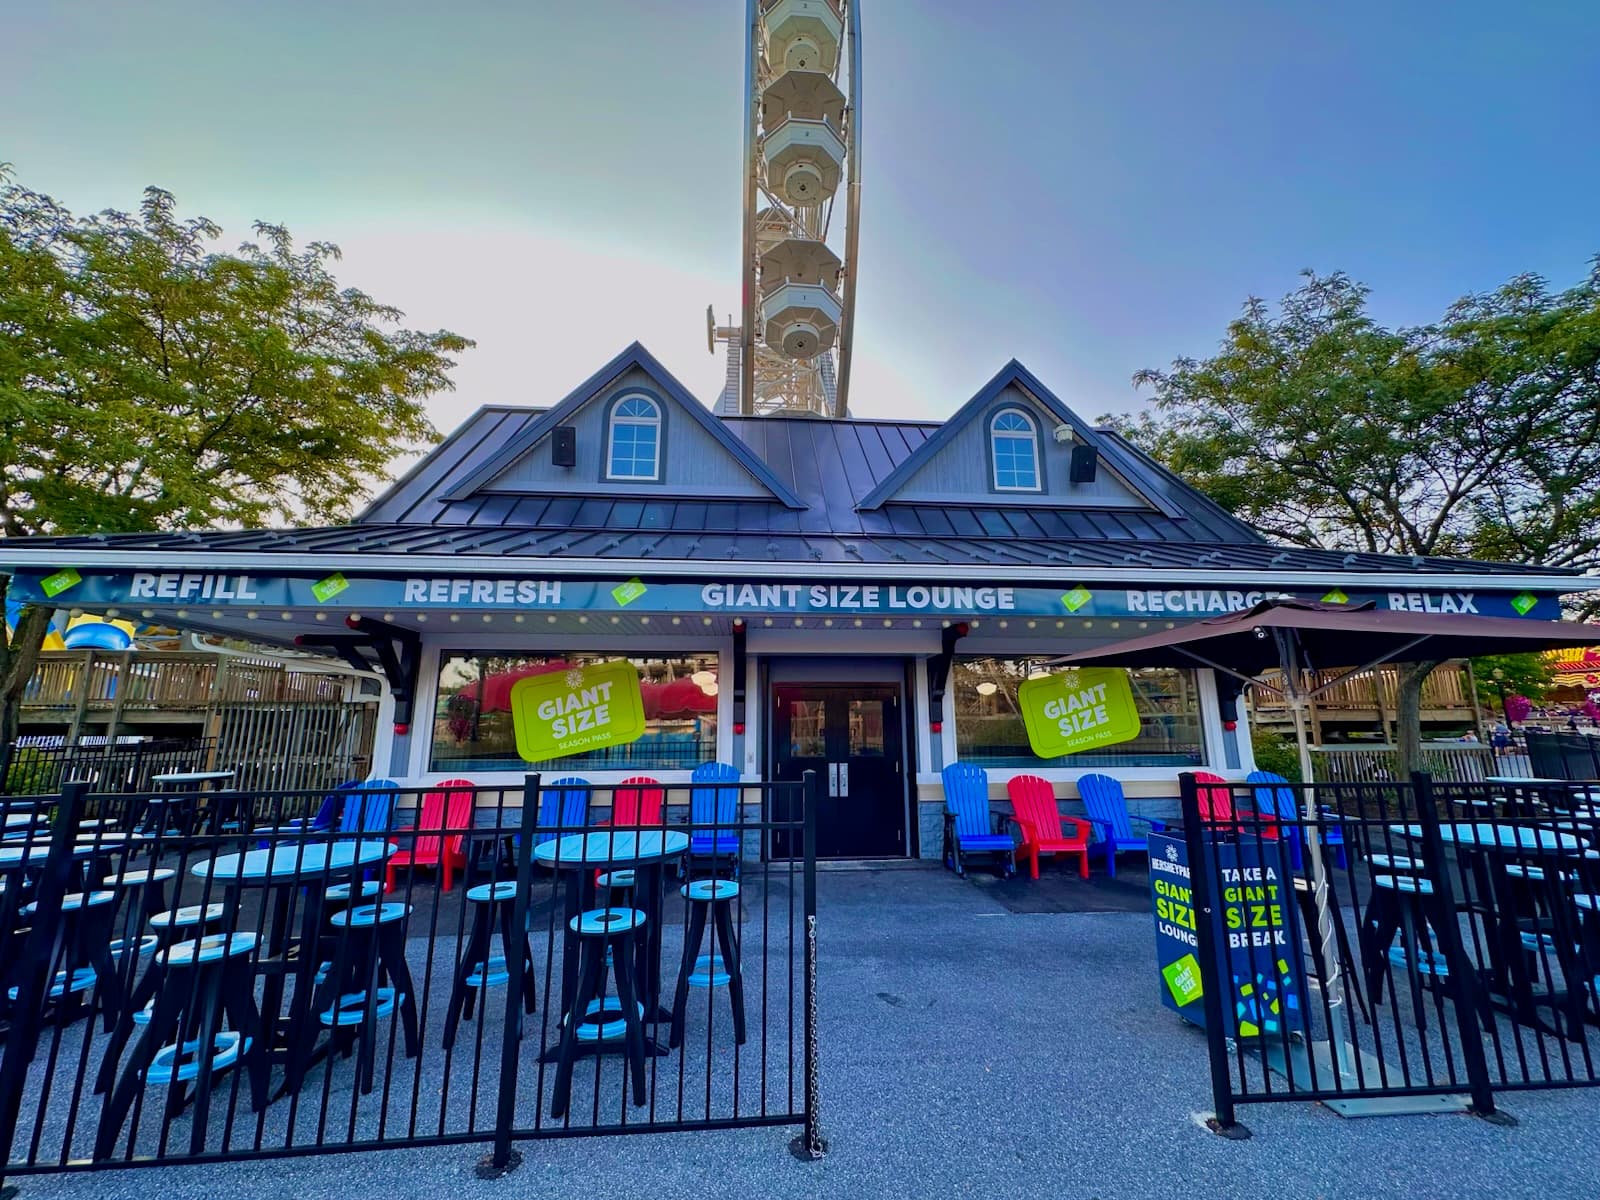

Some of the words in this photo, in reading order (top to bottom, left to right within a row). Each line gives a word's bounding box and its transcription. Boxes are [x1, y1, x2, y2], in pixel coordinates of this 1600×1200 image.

[130, 573, 256, 599] REFILL
[404, 579, 561, 604] REFRESH
[701, 584, 801, 606] GIANT
[809, 585, 879, 607] SIZE
[889, 587, 1014, 609] LOUNGE
[1388, 593, 1479, 613] RELAX
[538, 681, 613, 720] GIANT
[1044, 683, 1106, 719] GIANT
[552, 704, 611, 739] SIZE
[1058, 704, 1109, 737] SIZE
[559, 737, 590, 749] SEASON
[592, 732, 611, 742] PASS
[1067, 736, 1094, 747] SEASON
[1095, 731, 1112, 740] PASS
[1222, 868, 1262, 882] TAKE
[1266, 867, 1277, 881] A
[1155, 880, 1192, 904] GIAN
[1225, 885, 1278, 902] GIANT
[1226, 905, 1282, 928] SZE
[1159, 921, 1198, 948] LOUNG
[1229, 930, 1286, 948] BREAK
